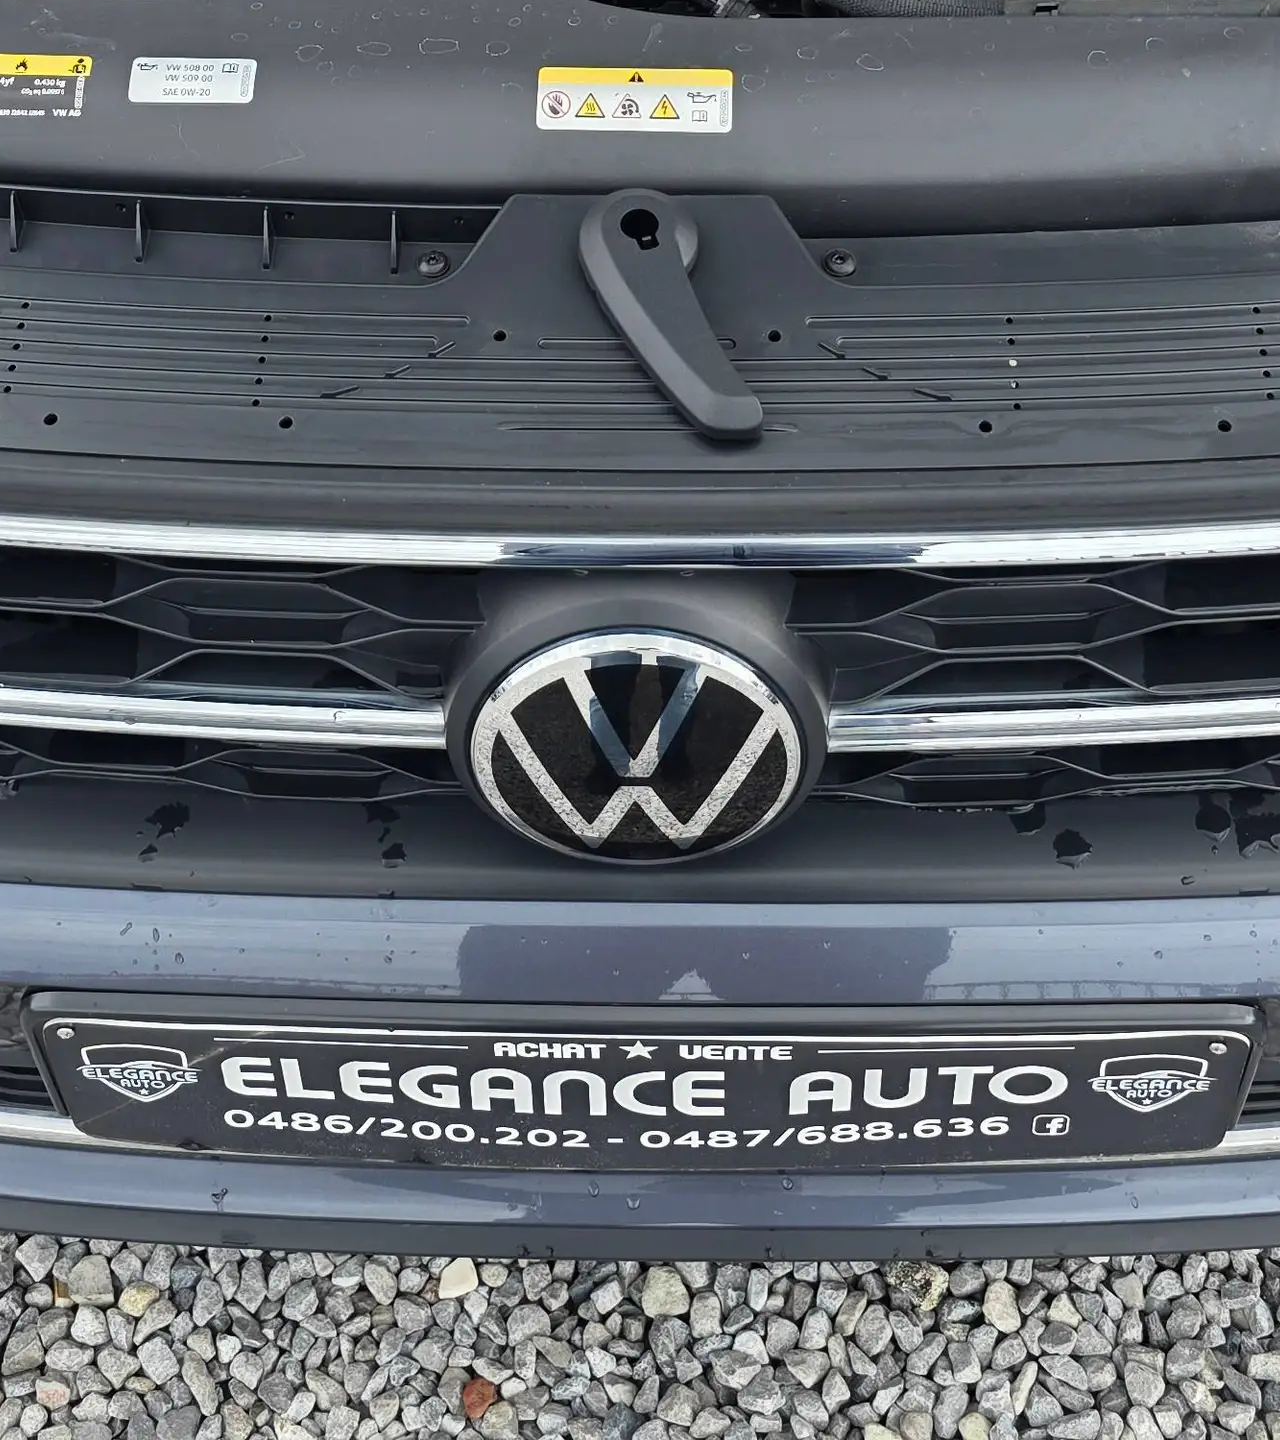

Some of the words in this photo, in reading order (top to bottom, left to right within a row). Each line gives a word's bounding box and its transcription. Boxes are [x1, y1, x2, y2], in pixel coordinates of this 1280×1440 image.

[184, 64, 200, 72] 508
[165, 74, 180, 82] VW
[162, 88, 179, 96] SAE
[180, 88, 211, 96] 0W-20
[52, 109, 68, 117] VW
[69, 109, 82, 117] AG
[482, 644, 788, 852] VW
[494, 1041, 608, 1060] ACHAT
[678, 1044, 794, 1061] VENTE
[82, 1067, 199, 1082] ELEGANCE
[120, 1078, 166, 1089] AUTO
[220, 1056, 726, 1117] ELEGANCE
[789, 1064, 1069, 1116] AUTO
[1091, 1079, 1211, 1091] ELEGANCE
[1125, 1089, 1173, 1099] AUTO
[223, 1109, 591, 1148] 0486/200.202
[639, 1116, 1011, 1149] 0487/688.636
